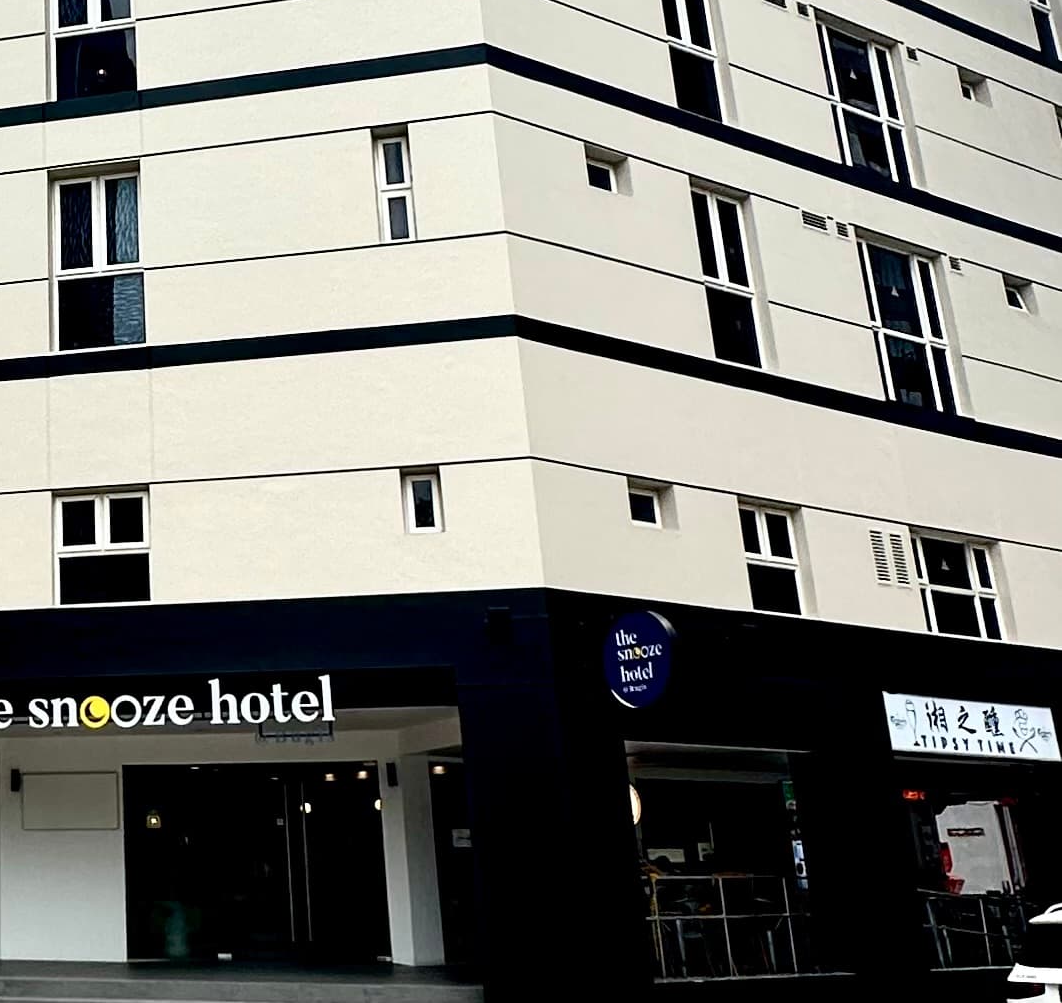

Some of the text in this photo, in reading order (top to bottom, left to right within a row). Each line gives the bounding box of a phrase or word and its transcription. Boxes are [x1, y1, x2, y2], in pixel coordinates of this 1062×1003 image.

[616, 629, 637, 646] the
[618, 643, 662, 661] snooze
[620, 661, 653, 683] hotel
[28, 694, 194, 730] snooze
[208, 674, 336, 725] hotel
